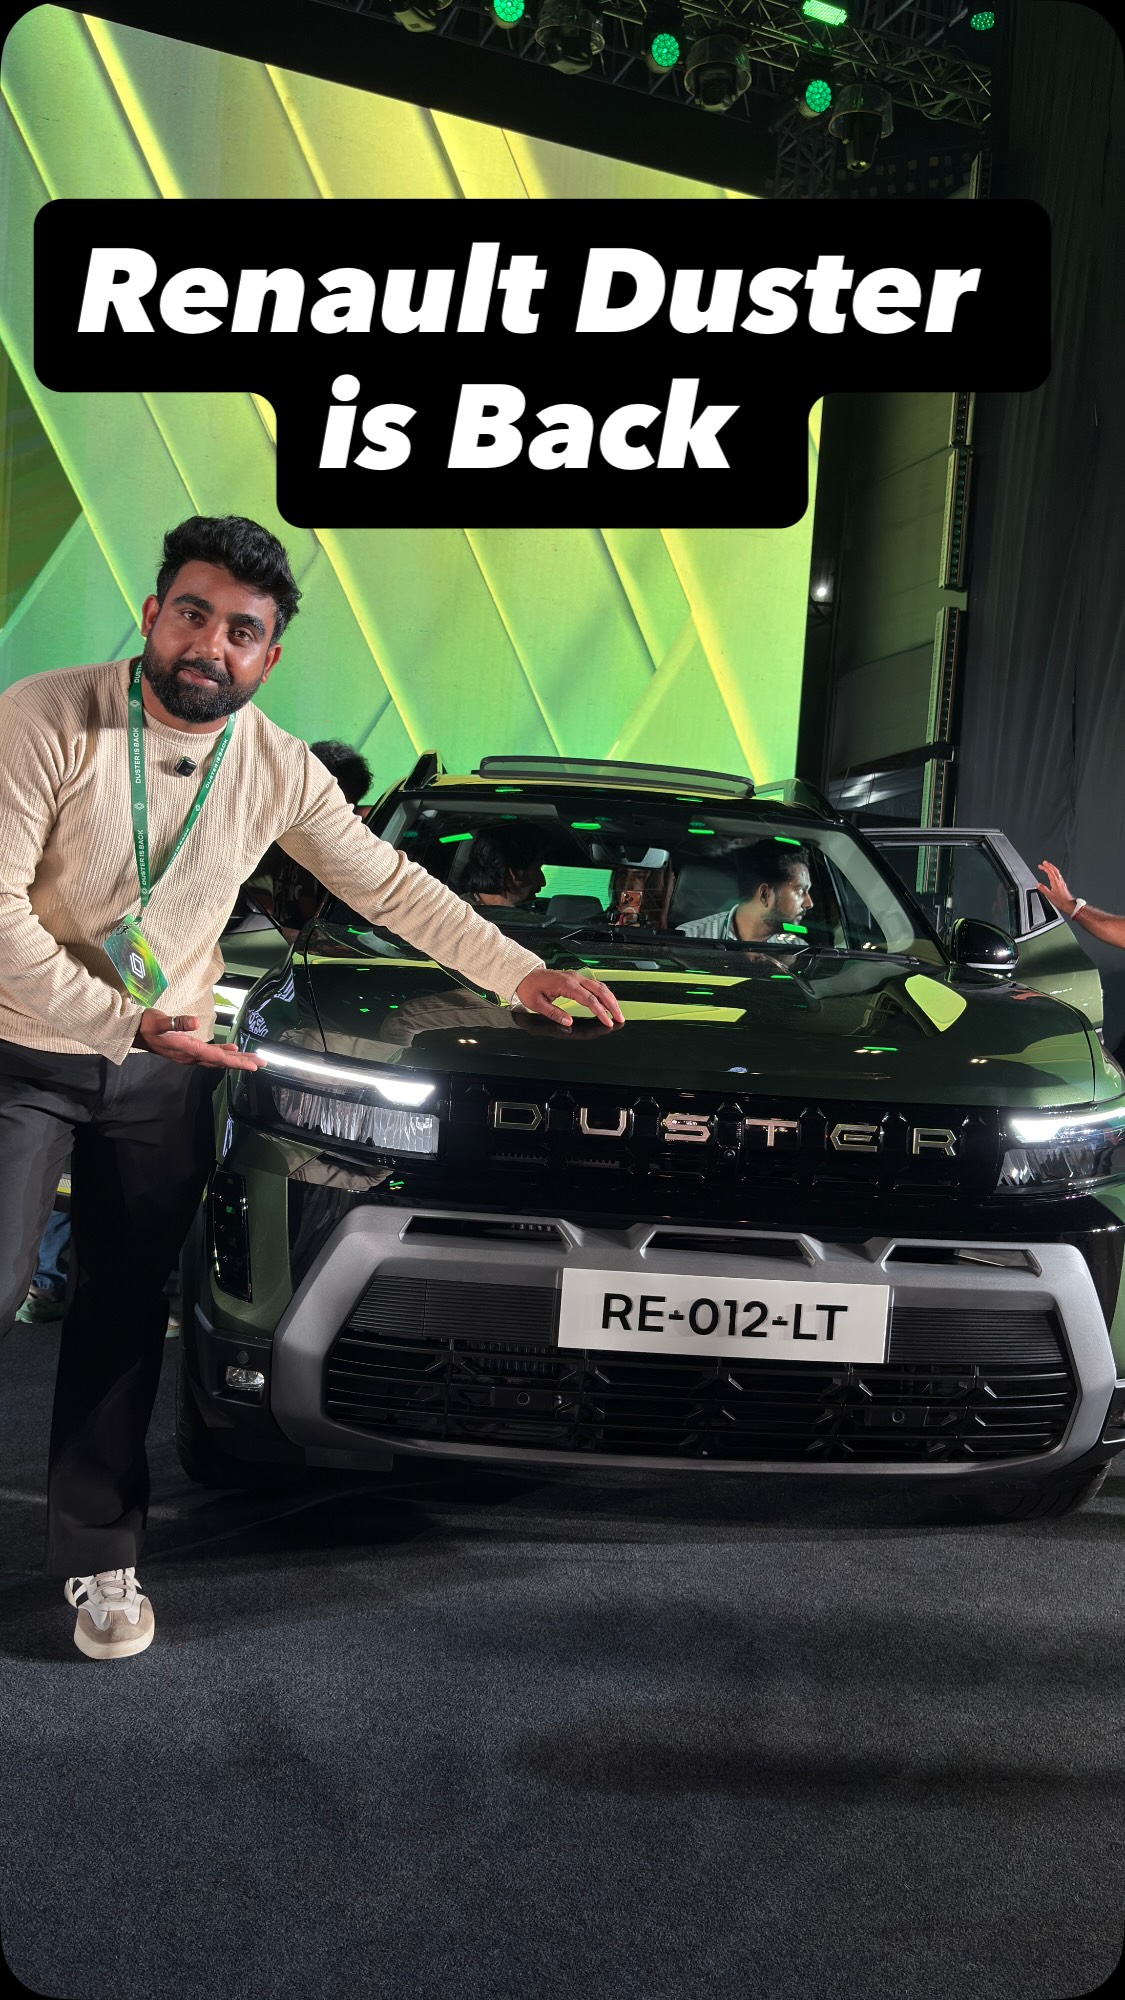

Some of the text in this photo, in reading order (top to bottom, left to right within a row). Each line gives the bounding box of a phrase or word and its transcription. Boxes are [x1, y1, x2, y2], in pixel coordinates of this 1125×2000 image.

[133, 661, 143, 684] DUST
[132, 727, 140, 747] BACK
[218, 738, 229, 757] BACK
[134, 755, 142, 784] DUSTER
[137, 829, 145, 850] BACK
[494, 1100, 957, 1157] DUSTER
[601, 1292, 849, 1341] RE-012-LT
